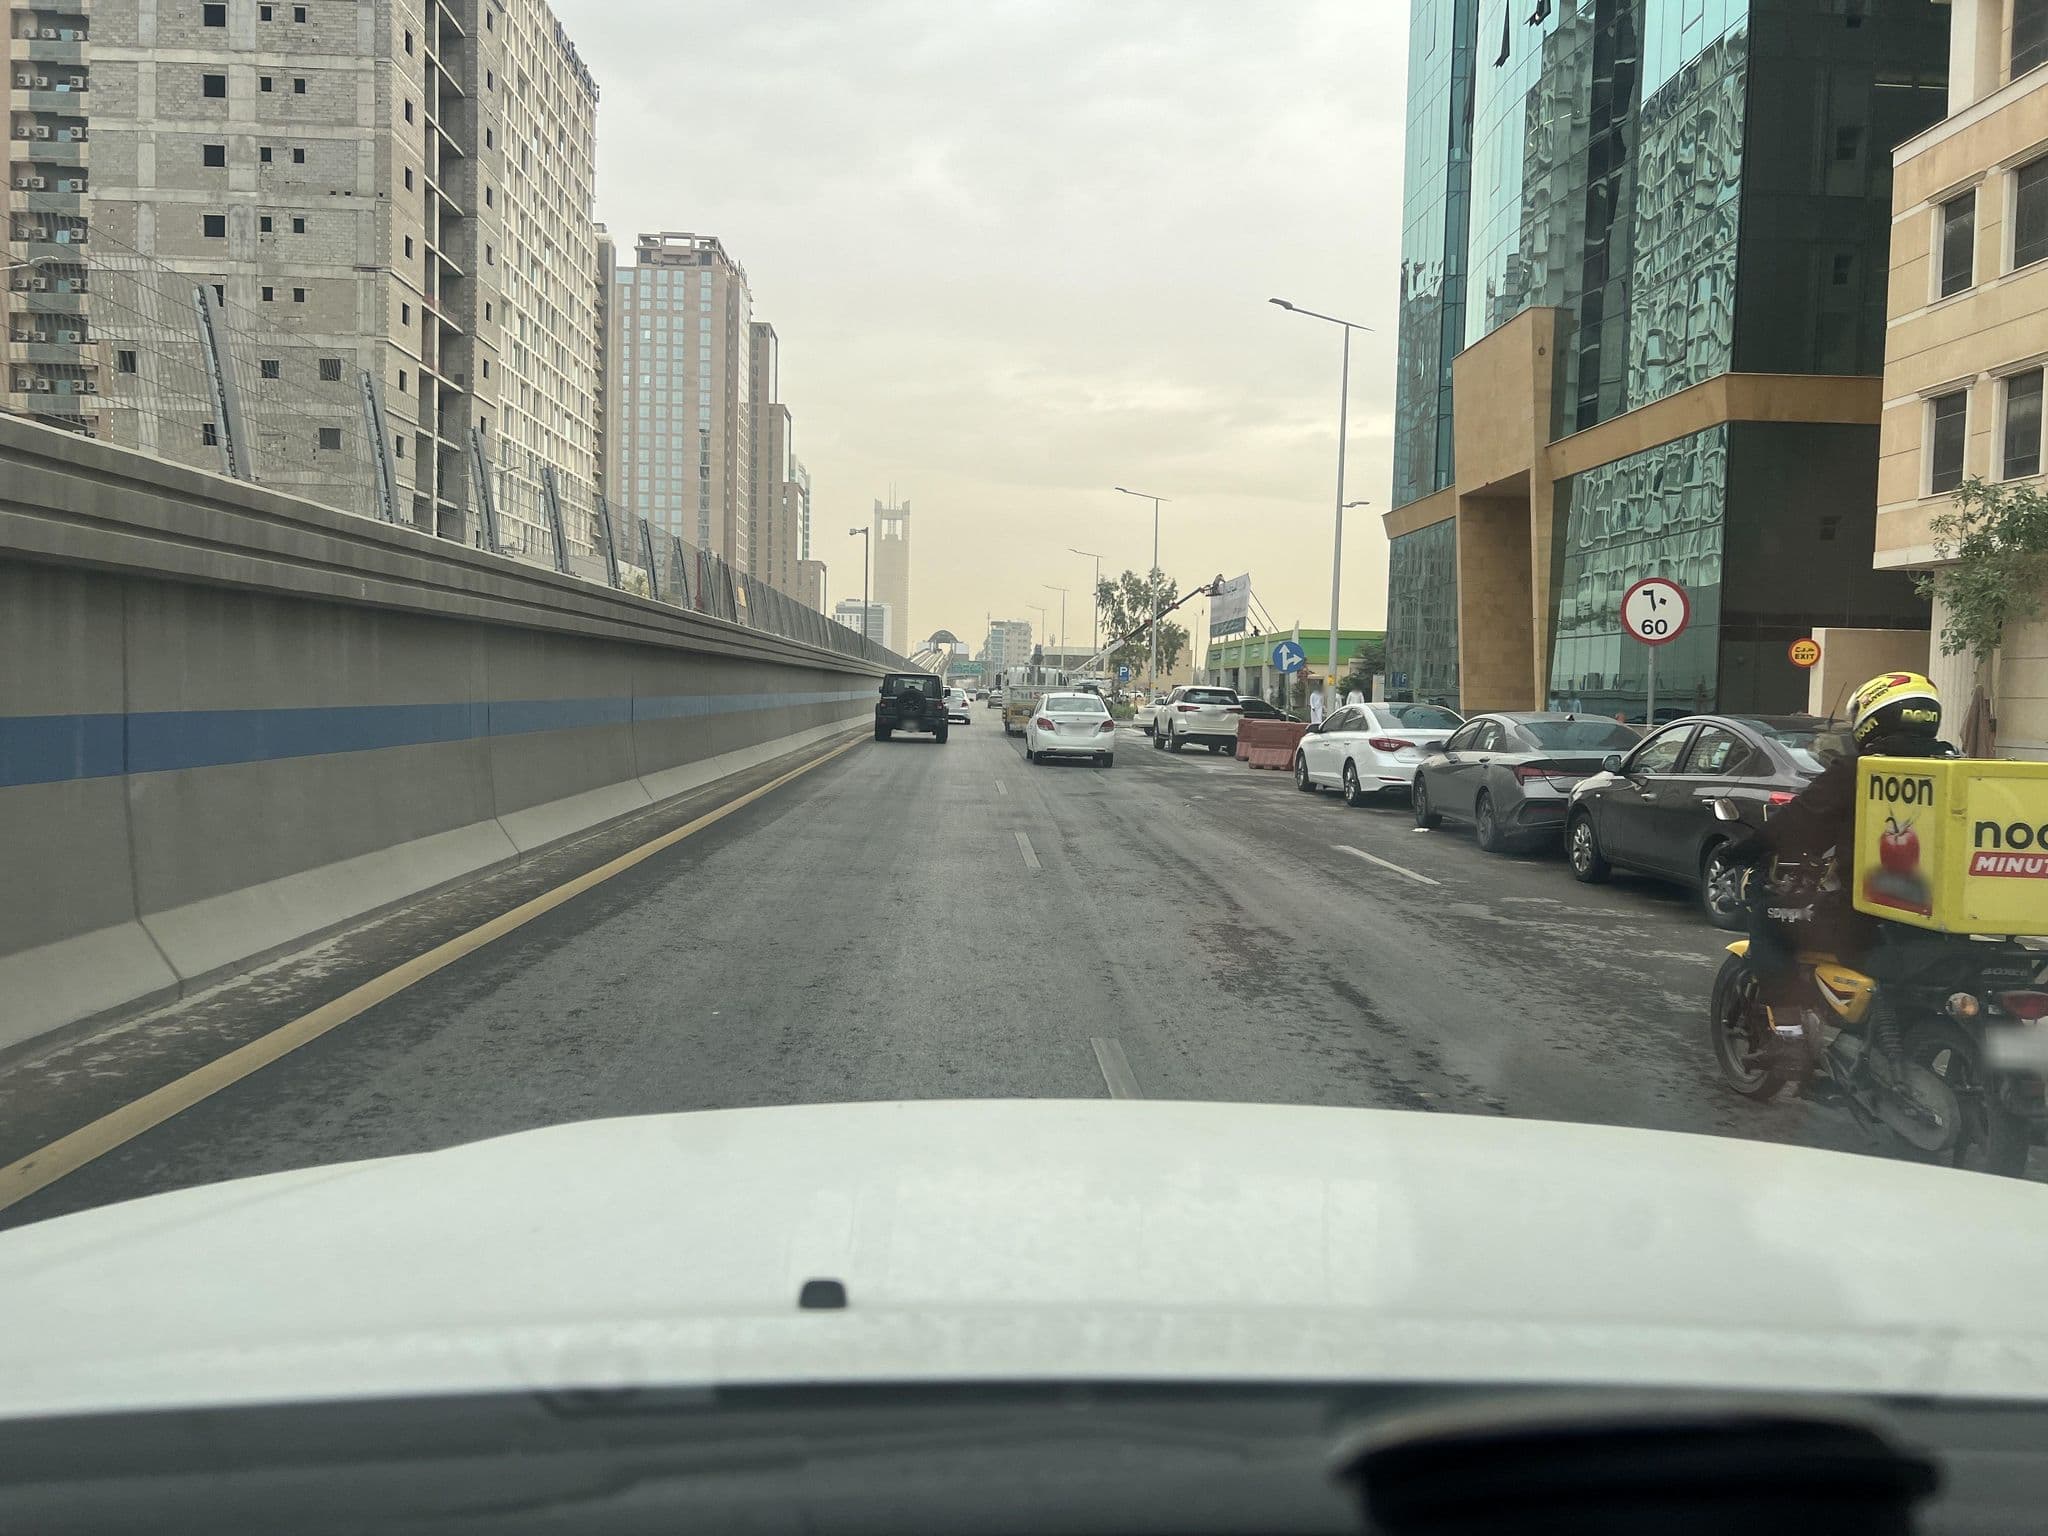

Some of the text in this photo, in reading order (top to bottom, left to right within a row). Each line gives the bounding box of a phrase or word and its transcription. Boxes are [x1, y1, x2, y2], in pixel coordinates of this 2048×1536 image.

[1642, 589, 1667, 612] ٦٠
[1641, 619, 1668, 635] 60
[1119, 666, 1128, 676] P
[1869, 774, 1933, 807] noon
[1975, 856, 2048, 874] MINU
